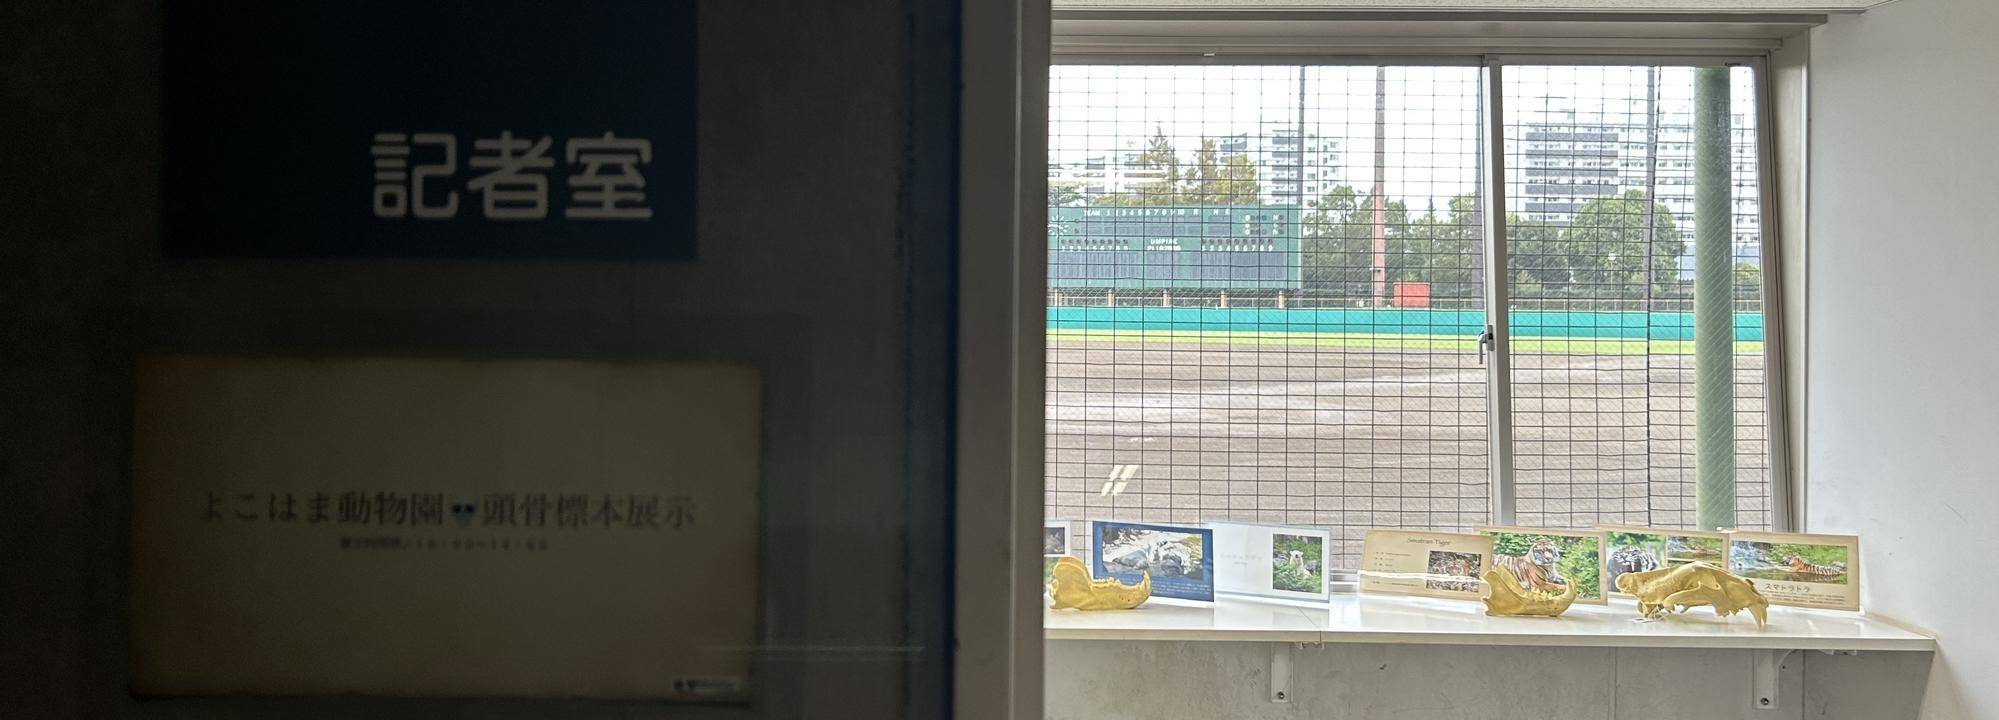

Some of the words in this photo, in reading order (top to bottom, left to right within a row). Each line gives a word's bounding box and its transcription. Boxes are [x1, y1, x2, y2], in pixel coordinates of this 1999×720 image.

[371, 130, 653, 220] 記者室
[1083, 208, 1101, 217] TEAM
[199, 489, 445, 527] よこはま動物園
[482, 489, 697, 529] 頭骨標本展示
[1765, 583, 1810, 593] スマトラトラ
